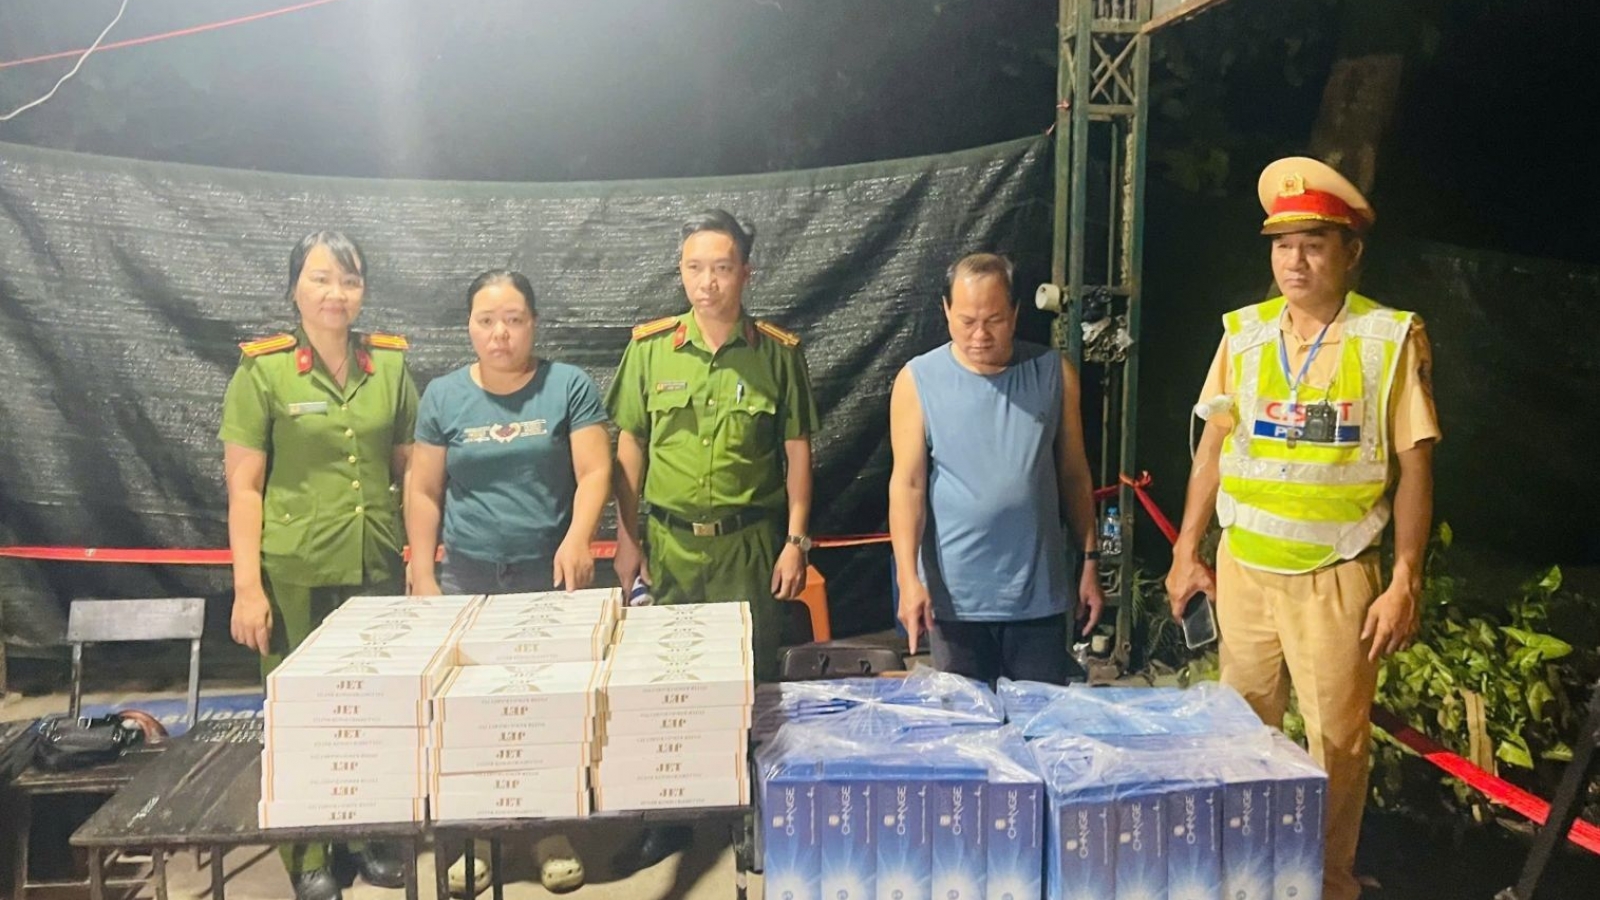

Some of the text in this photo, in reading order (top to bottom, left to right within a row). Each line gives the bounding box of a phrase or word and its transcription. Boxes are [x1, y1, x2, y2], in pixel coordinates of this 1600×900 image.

[514, 643, 540, 652] JET
[336, 680, 364, 690] JET
[661, 694, 689, 703] JET
[333, 705, 361, 714] JET
[501, 706, 529, 716] JET
[660, 719, 686, 728] JET
[334, 729, 362, 738] JET
[498, 731, 526, 741] JET
[656, 743, 682, 753] JET
[495, 749, 524, 758] JET
[330, 761, 358, 771] JET
[655, 763, 682, 772] JET
[493, 779, 520, 789] JET
[331, 786, 358, 796] JET
[659, 788, 686, 797] JET
[495, 798, 523, 807] JET
[329, 811, 356, 821] JET
